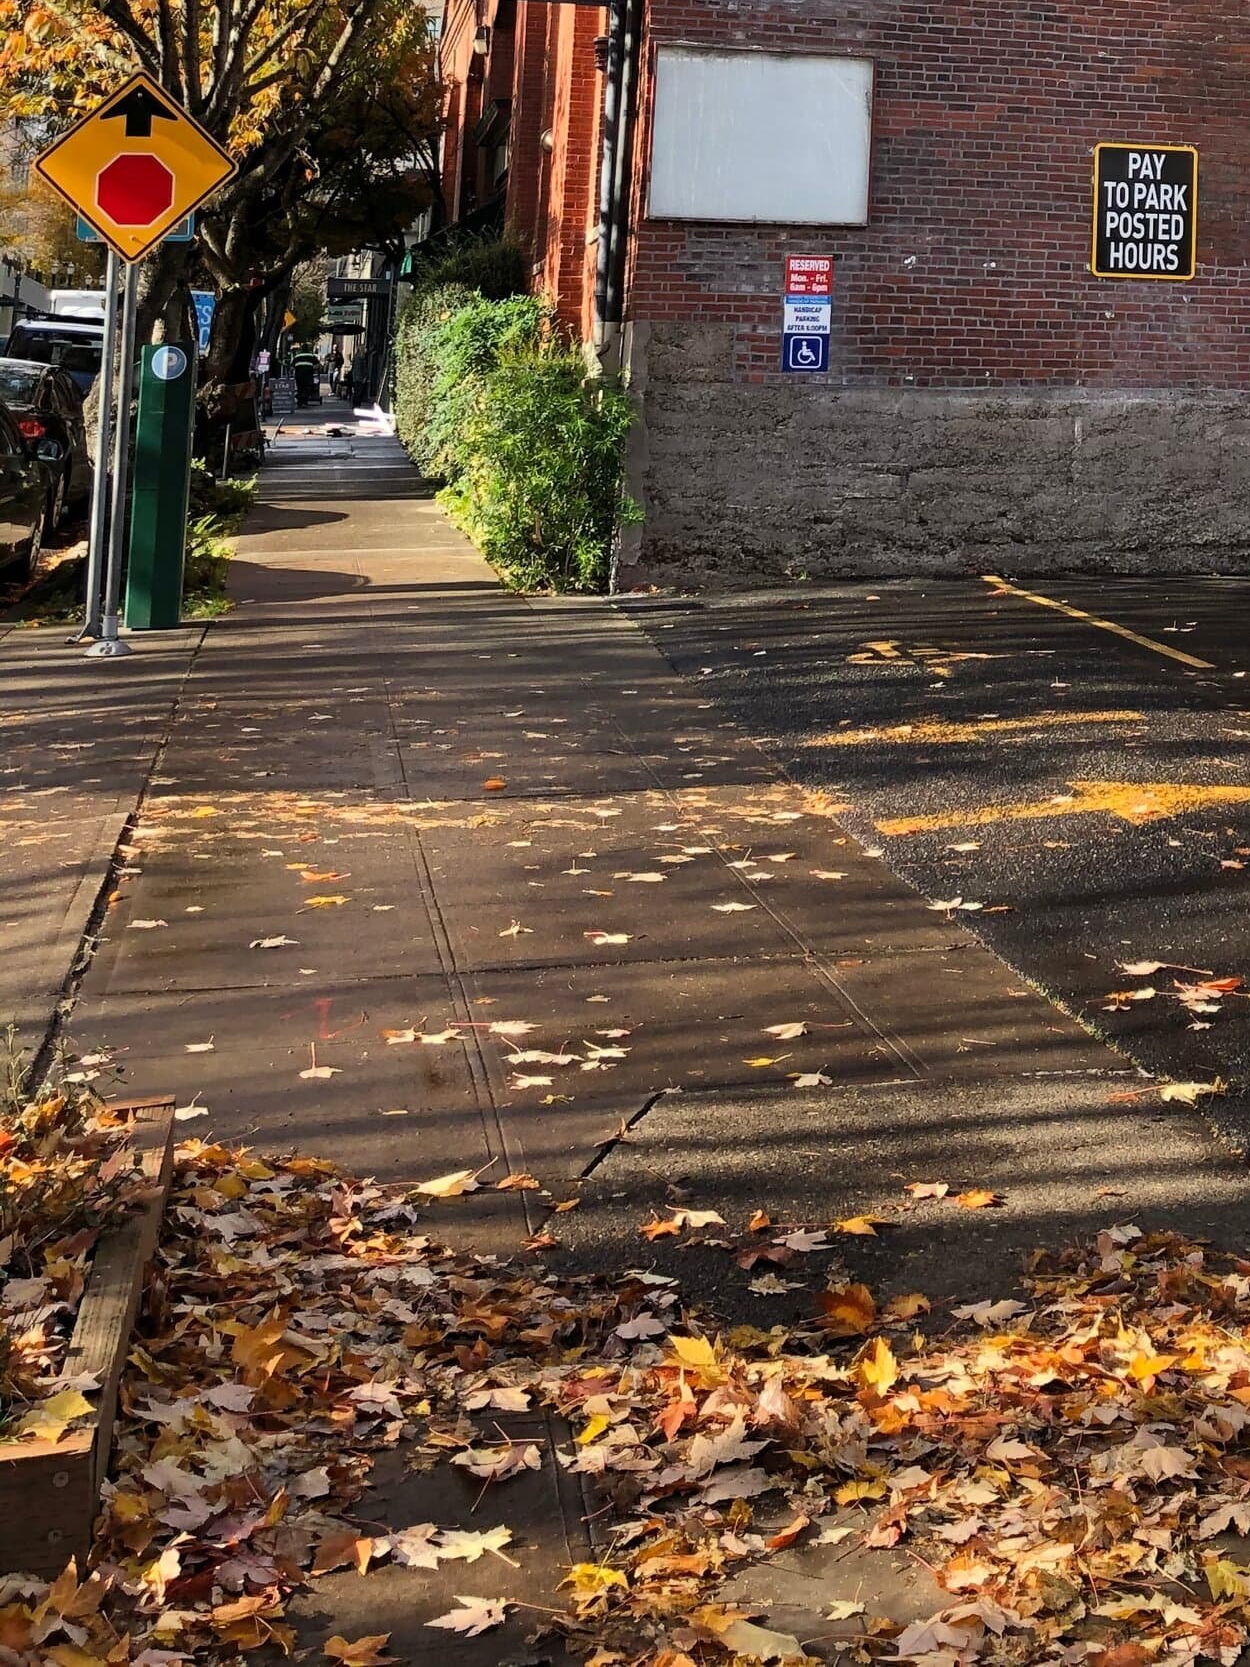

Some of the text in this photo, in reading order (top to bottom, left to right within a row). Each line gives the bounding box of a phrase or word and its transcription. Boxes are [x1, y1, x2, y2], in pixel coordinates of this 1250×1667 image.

[1128, 152, 1166, 180] PAY
[1104, 181, 1187, 211] TO PARK
[1106, 211, 1184, 241] POSTED
[790, 260, 830, 271] RESERVED
[1110, 241, 1179, 270] HOURS
[790, 274, 809, 282] Mon.
[163, 352, 179, 380] P
